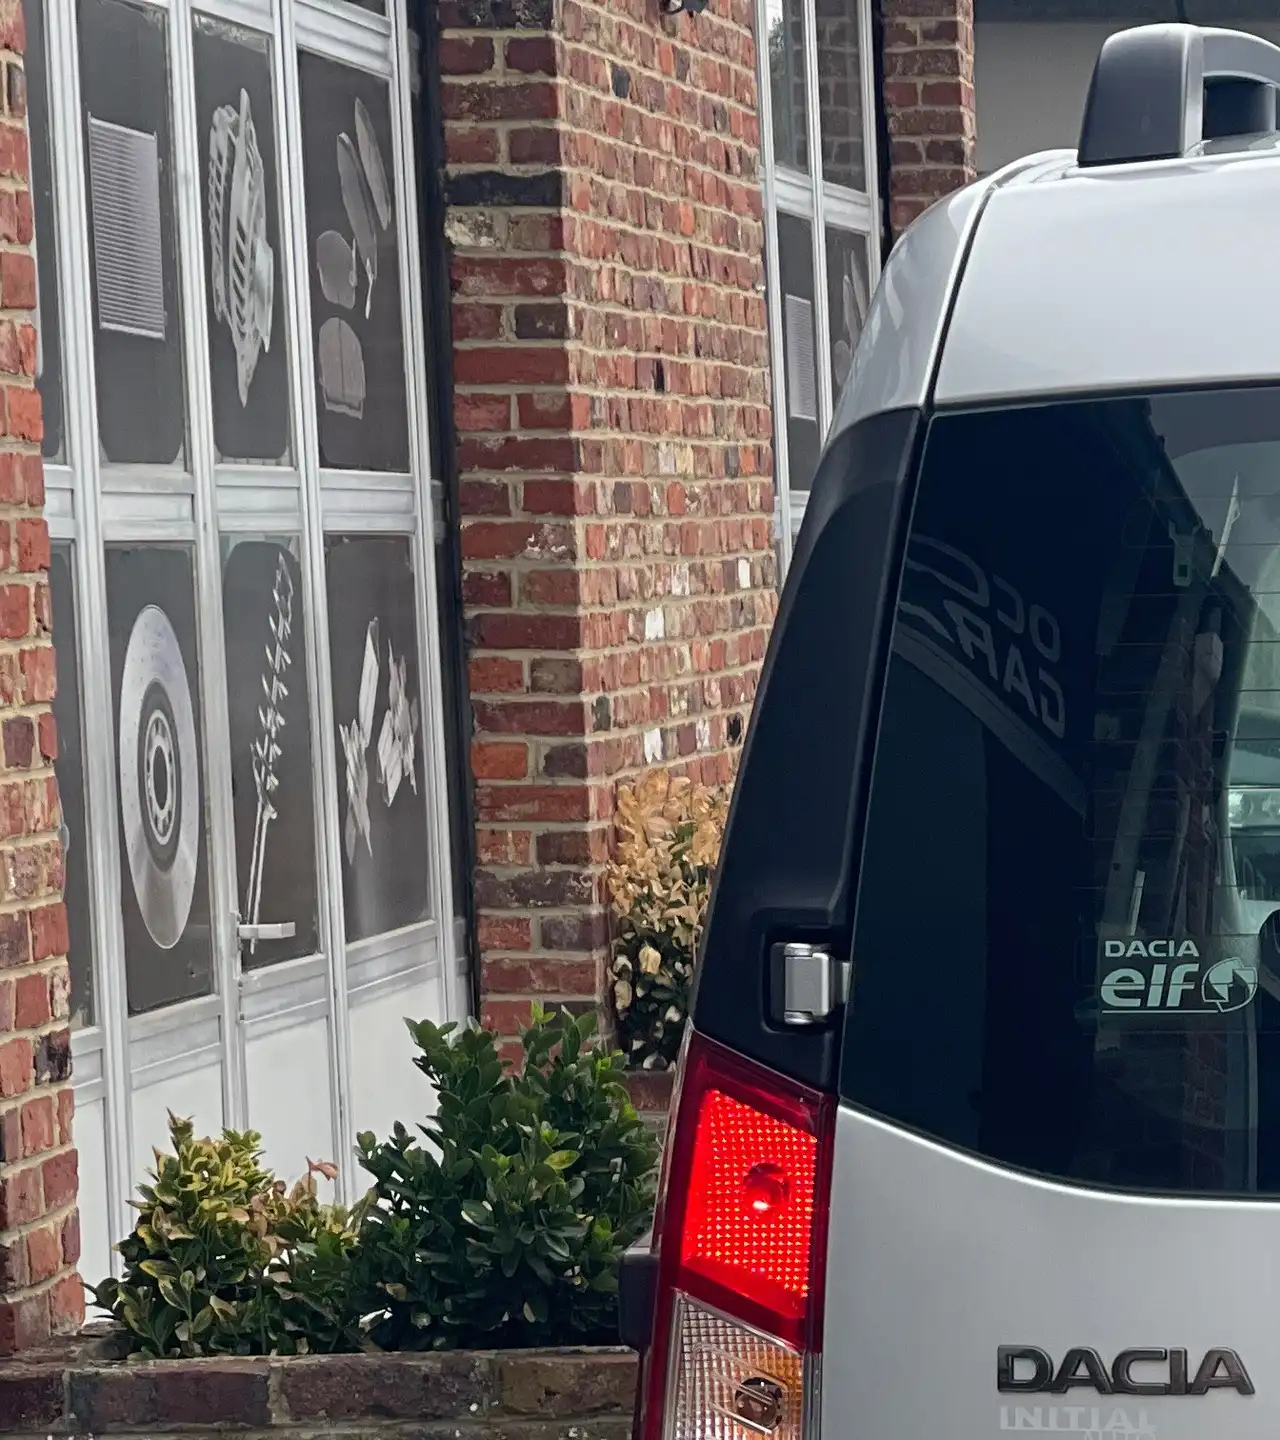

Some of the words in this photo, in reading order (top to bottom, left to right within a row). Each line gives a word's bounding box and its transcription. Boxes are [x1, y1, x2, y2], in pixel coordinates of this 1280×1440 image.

[1105, 940, 1200, 957] DACIA
[1101, 964, 1200, 1007] elf
[997, 1345, 1254, 1395] DACIA
[1000, 1407, 1157, 1431] INITIAL
